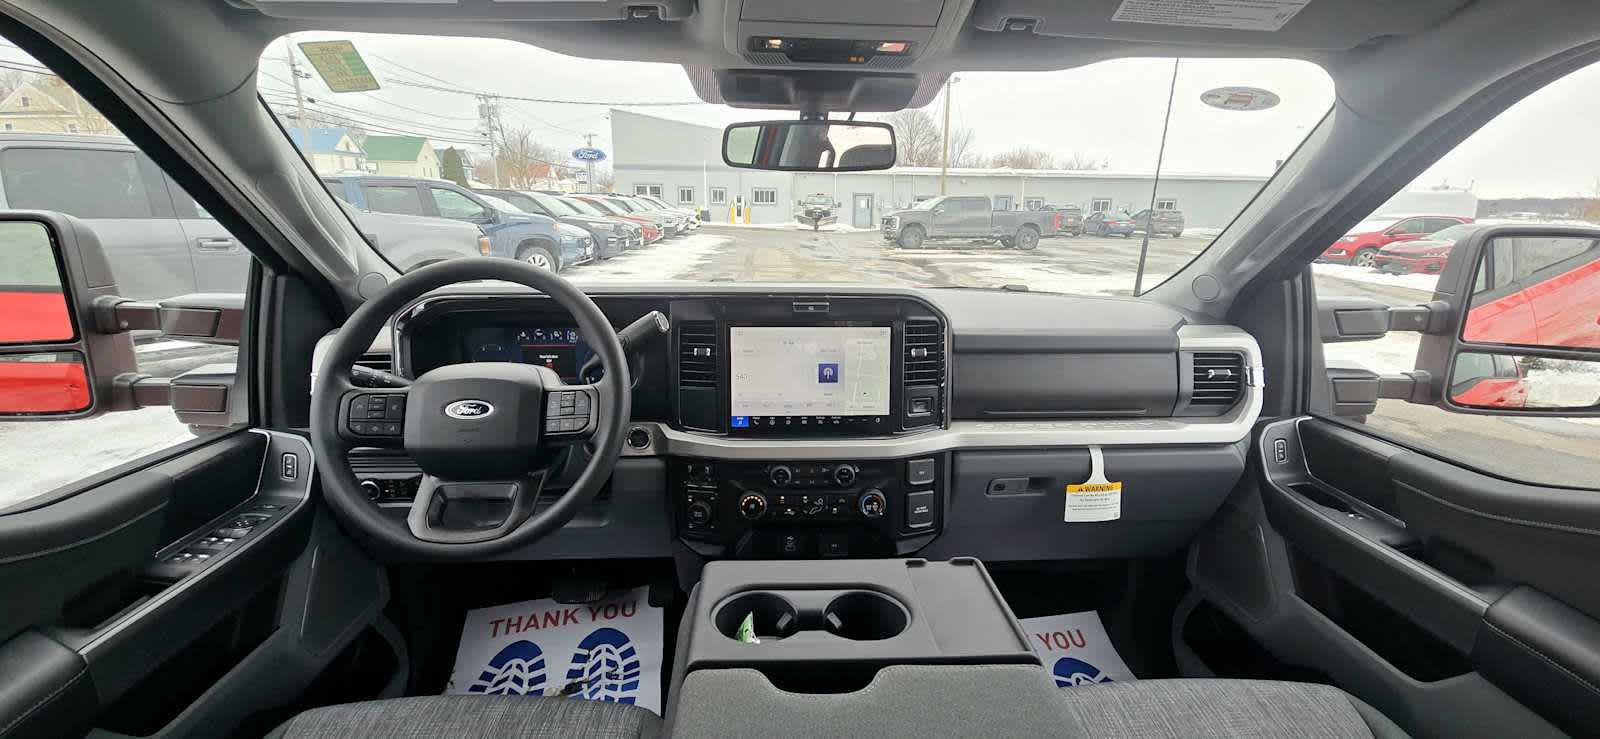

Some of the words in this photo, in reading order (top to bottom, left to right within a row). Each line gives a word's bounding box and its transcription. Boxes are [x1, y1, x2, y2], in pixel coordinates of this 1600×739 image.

[577, 150, 600, 160] Ford
[457, 403, 482, 415] Ford
[1084, 484, 1114, 493] WARNING
[490, 607, 579, 638] THANK
[588, 600, 638, 622] YOU
[1036, 629, 1087, 651] YOU
